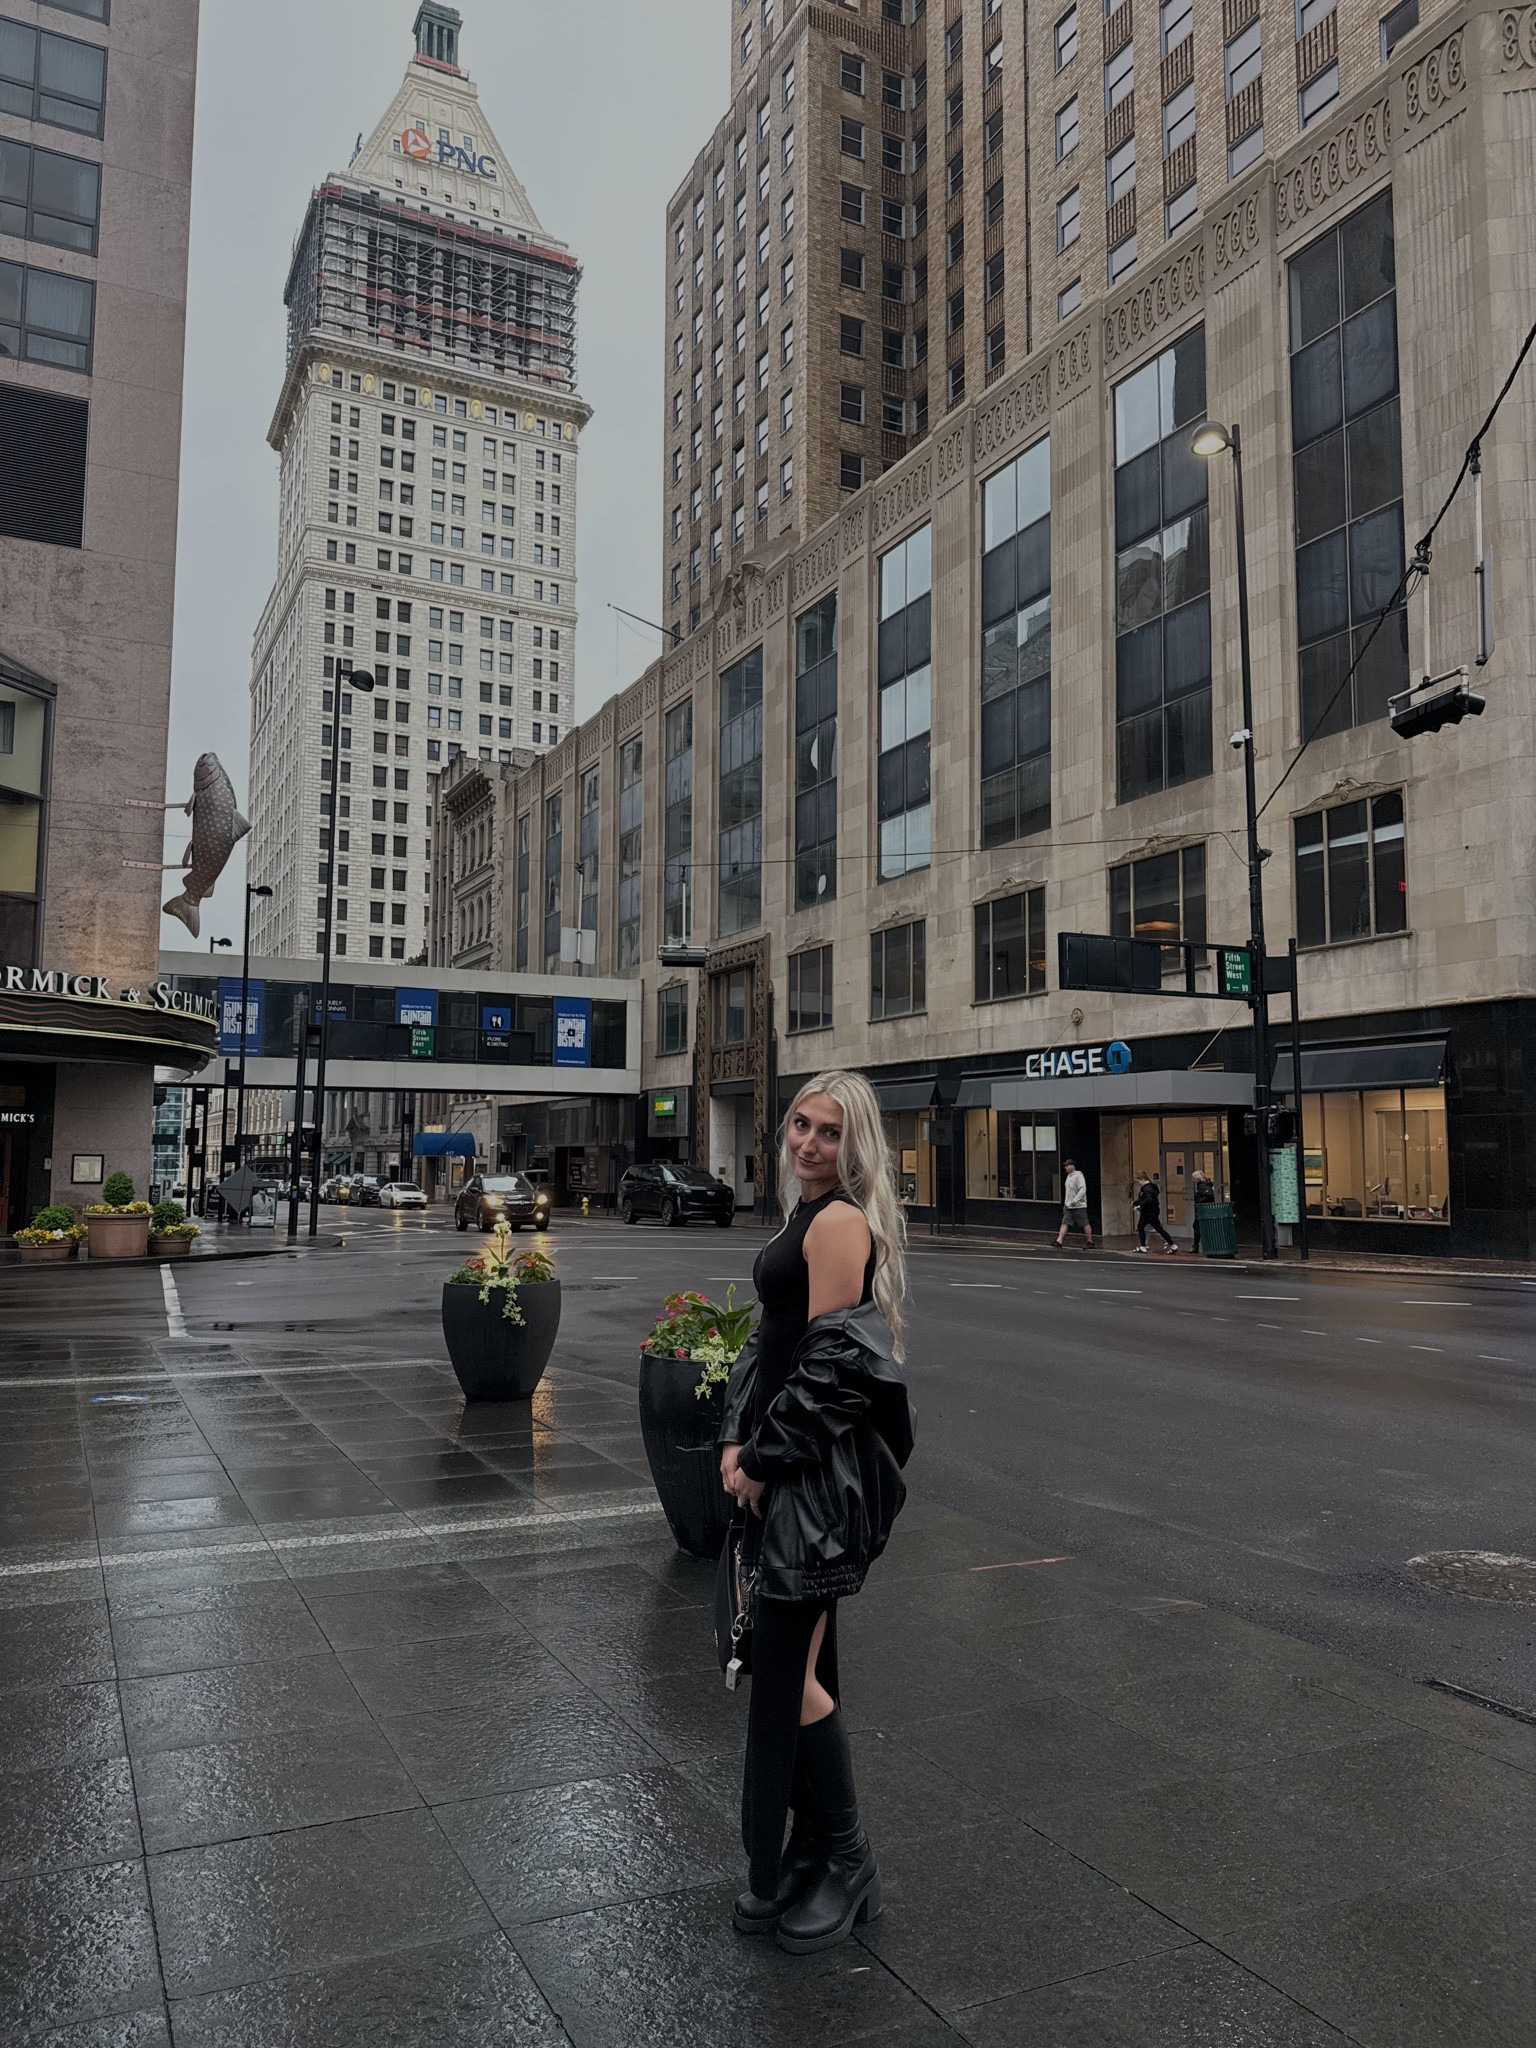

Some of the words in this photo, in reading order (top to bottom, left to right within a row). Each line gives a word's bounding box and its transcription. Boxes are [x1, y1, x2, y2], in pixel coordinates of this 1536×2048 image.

[436, 140, 497, 180] PNC
[1225, 952, 1241, 962] Fifth
[1225, 961, 1245, 971] Street
[1225, 970, 1242, 980] West
[0, 965, 112, 1000] RMICK
[412, 1034, 430, 1042] Street
[1025, 1047, 1105, 1078] CHASE
[655, 1100, 675, 1112] SUBWAY
